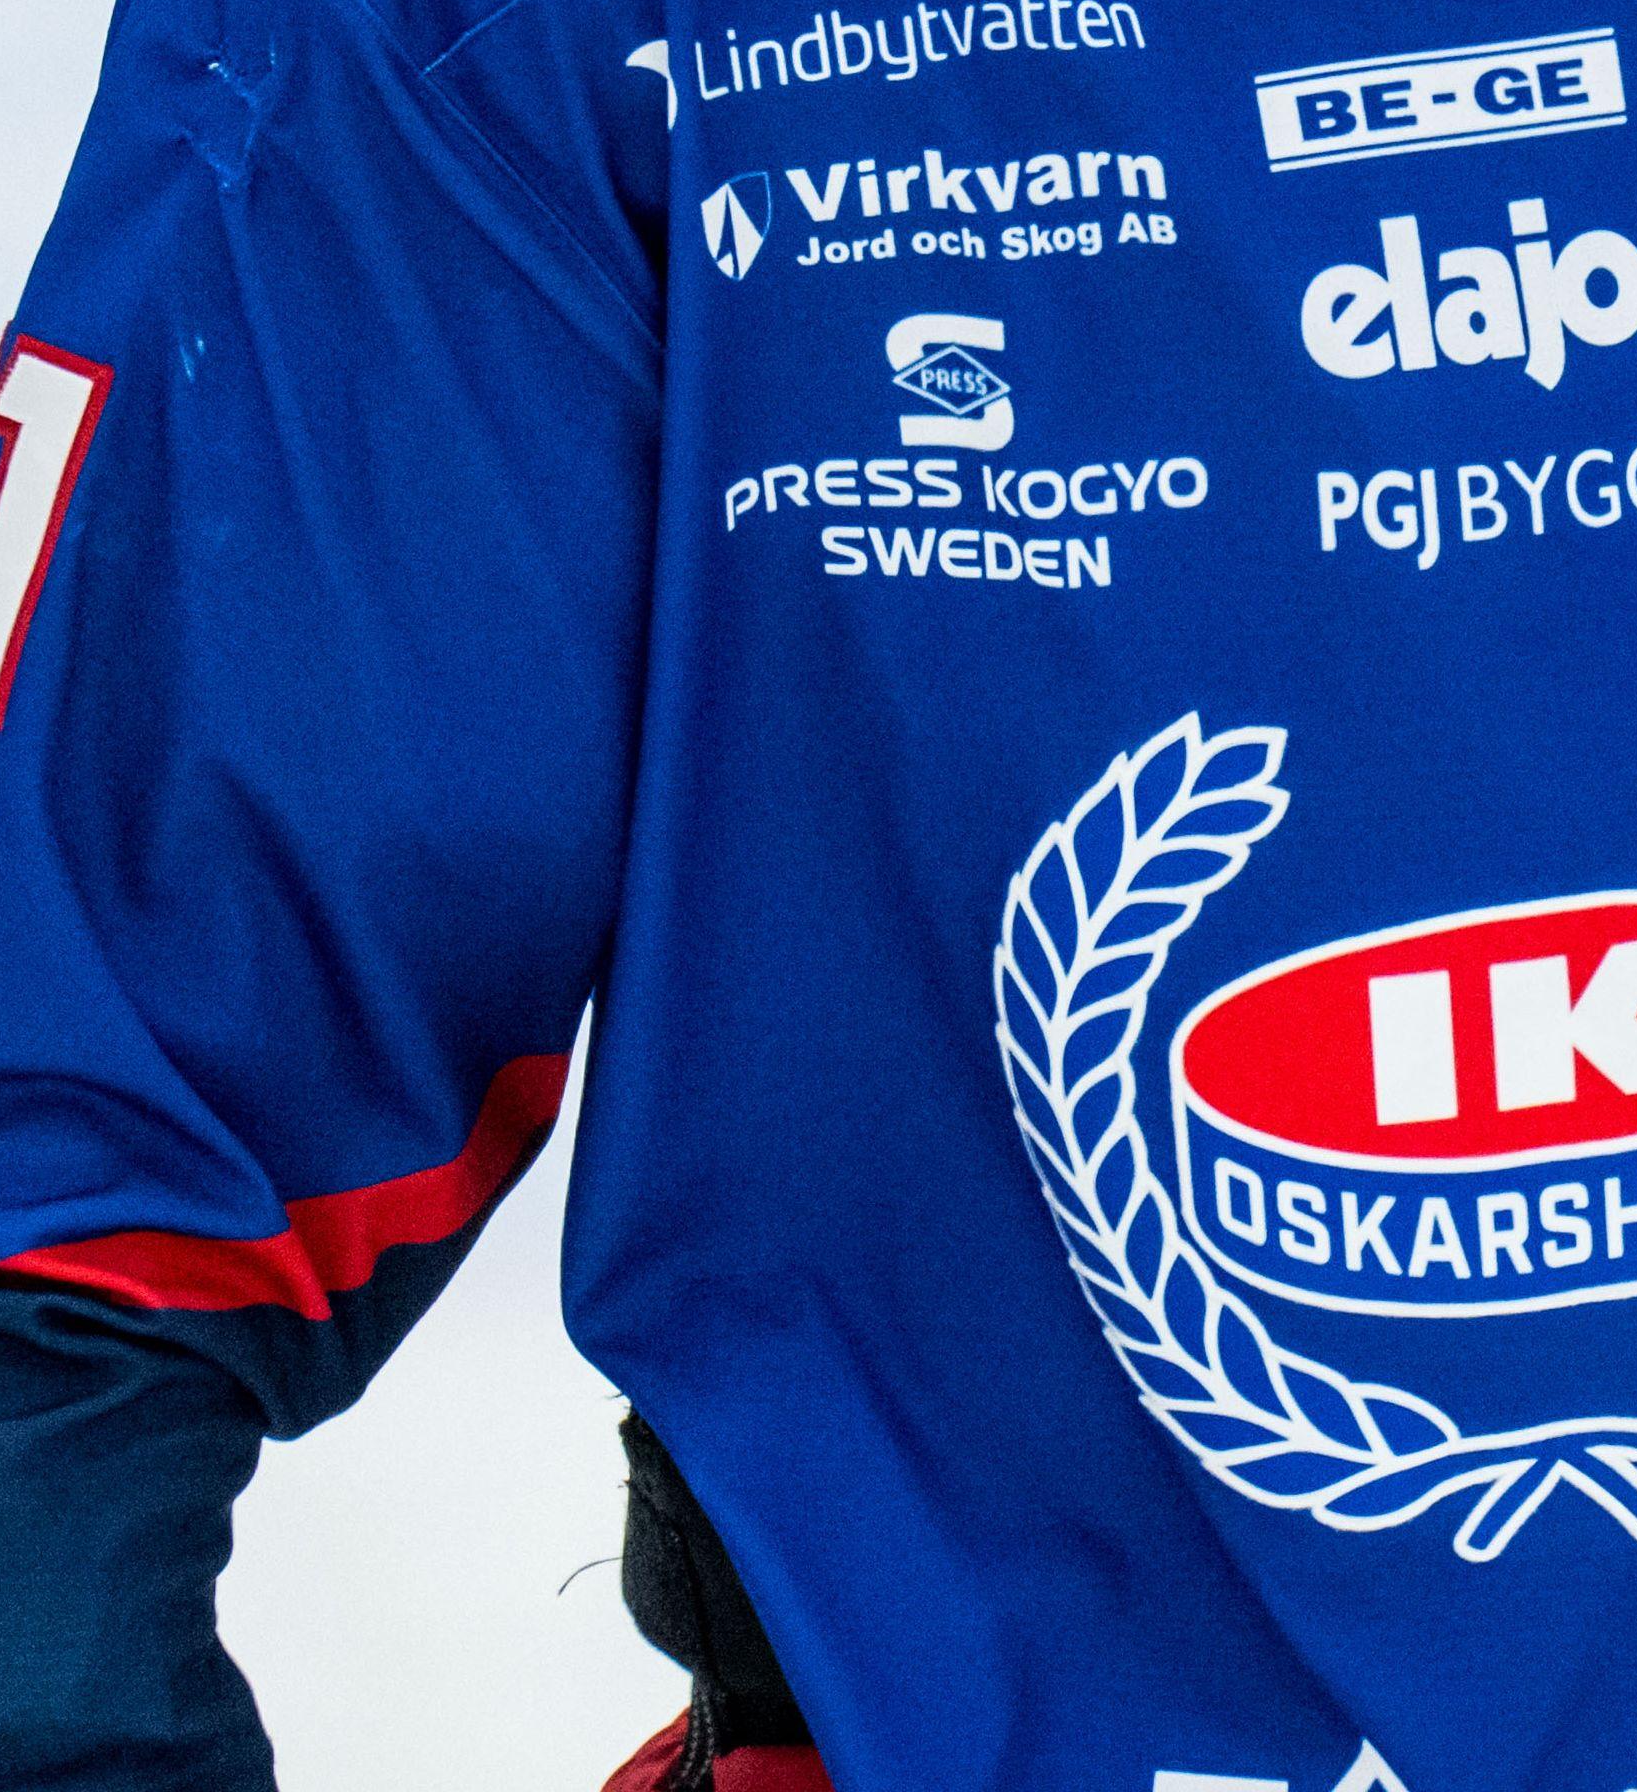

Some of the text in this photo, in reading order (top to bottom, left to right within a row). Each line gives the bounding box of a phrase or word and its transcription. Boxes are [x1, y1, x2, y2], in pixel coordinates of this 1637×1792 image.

[785, 149, 1166, 222] Virkvarn
[797, 212, 1177, 266] Jord och Skog AB
[920, 367, 989, 396] PRESS
[724, 457, 1208, 531] PRESS KOGYO
[821, 526, 1112, 589] SWEDEN
